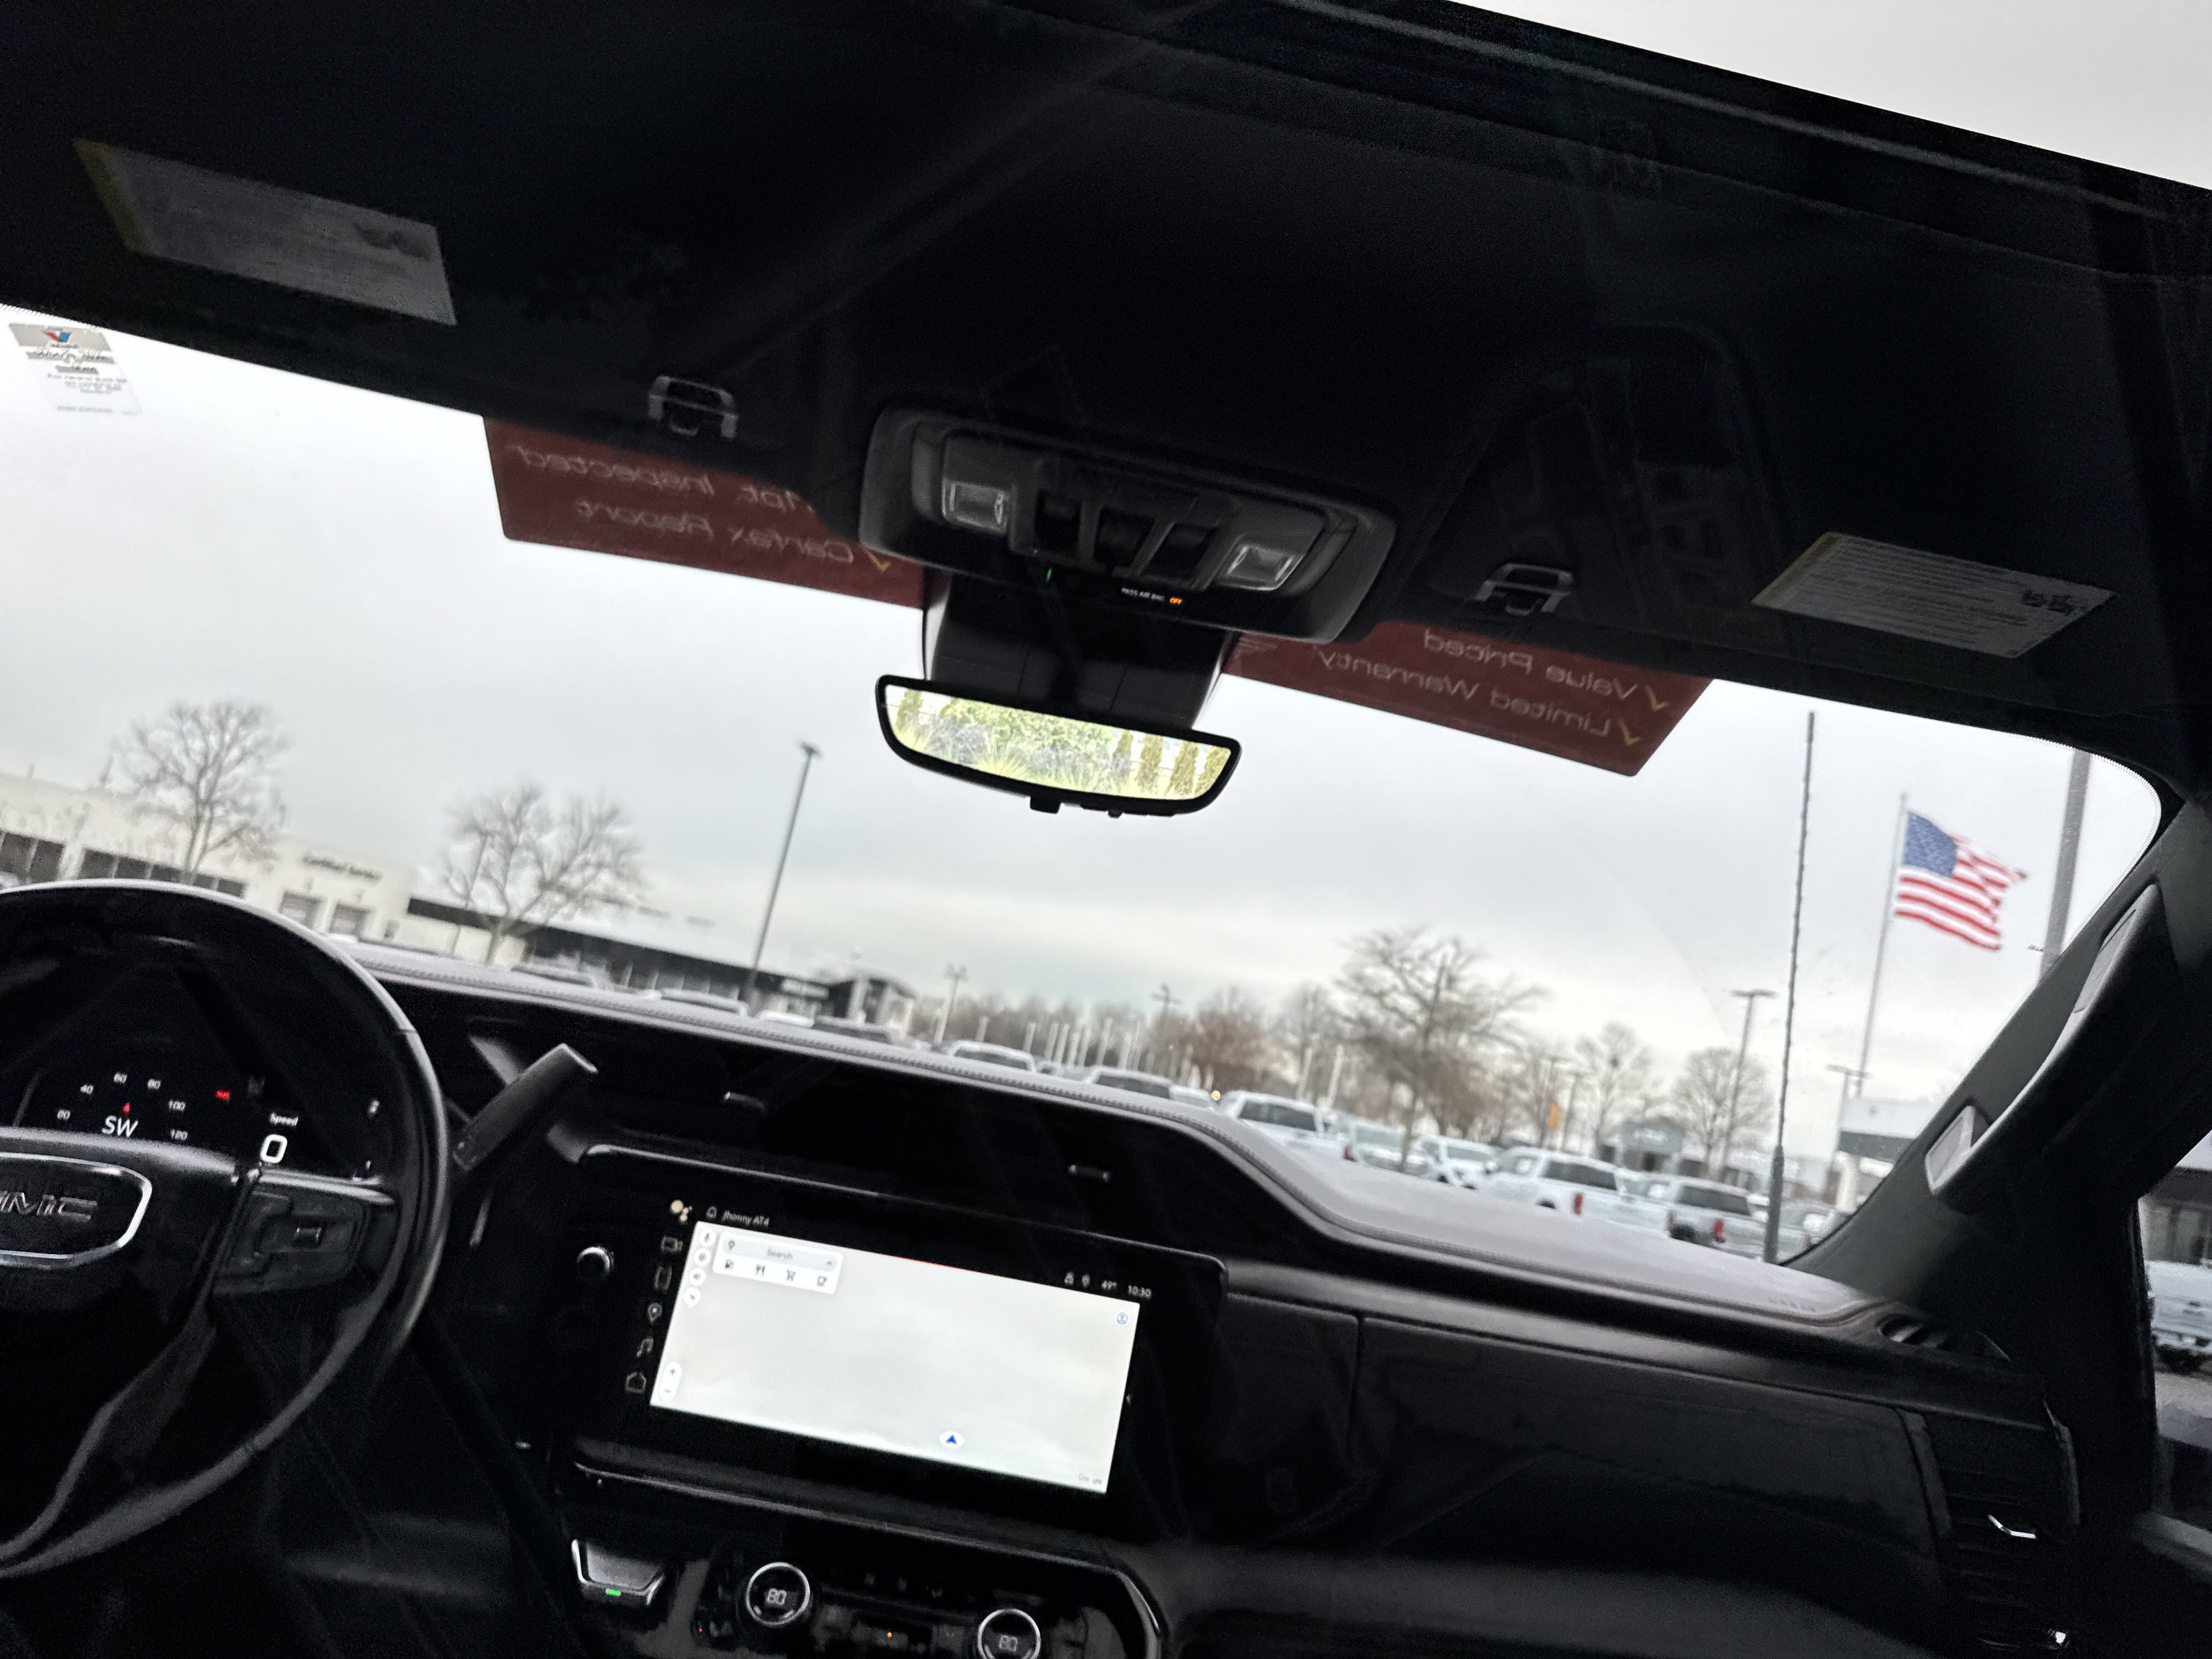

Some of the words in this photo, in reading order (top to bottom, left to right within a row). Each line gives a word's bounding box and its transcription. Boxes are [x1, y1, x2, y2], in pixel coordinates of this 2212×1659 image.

[1139, 590, 1150, 599] AIR
[1169, 597, 1183, 605] OFF
[80, 1084, 94, 1095] 40
[168, 1100, 186, 1111] 100
[101, 1115, 138, 1138] SW
[269, 1112, 299, 1127] Speed
[259, 1133, 288, 1164] 0
[0, 1189, 98, 1222] MC
[752, 1215, 770, 1228] AT4
[766, 1248, 793, 1260] Search
[1128, 1285, 1152, 1299] 10:30
